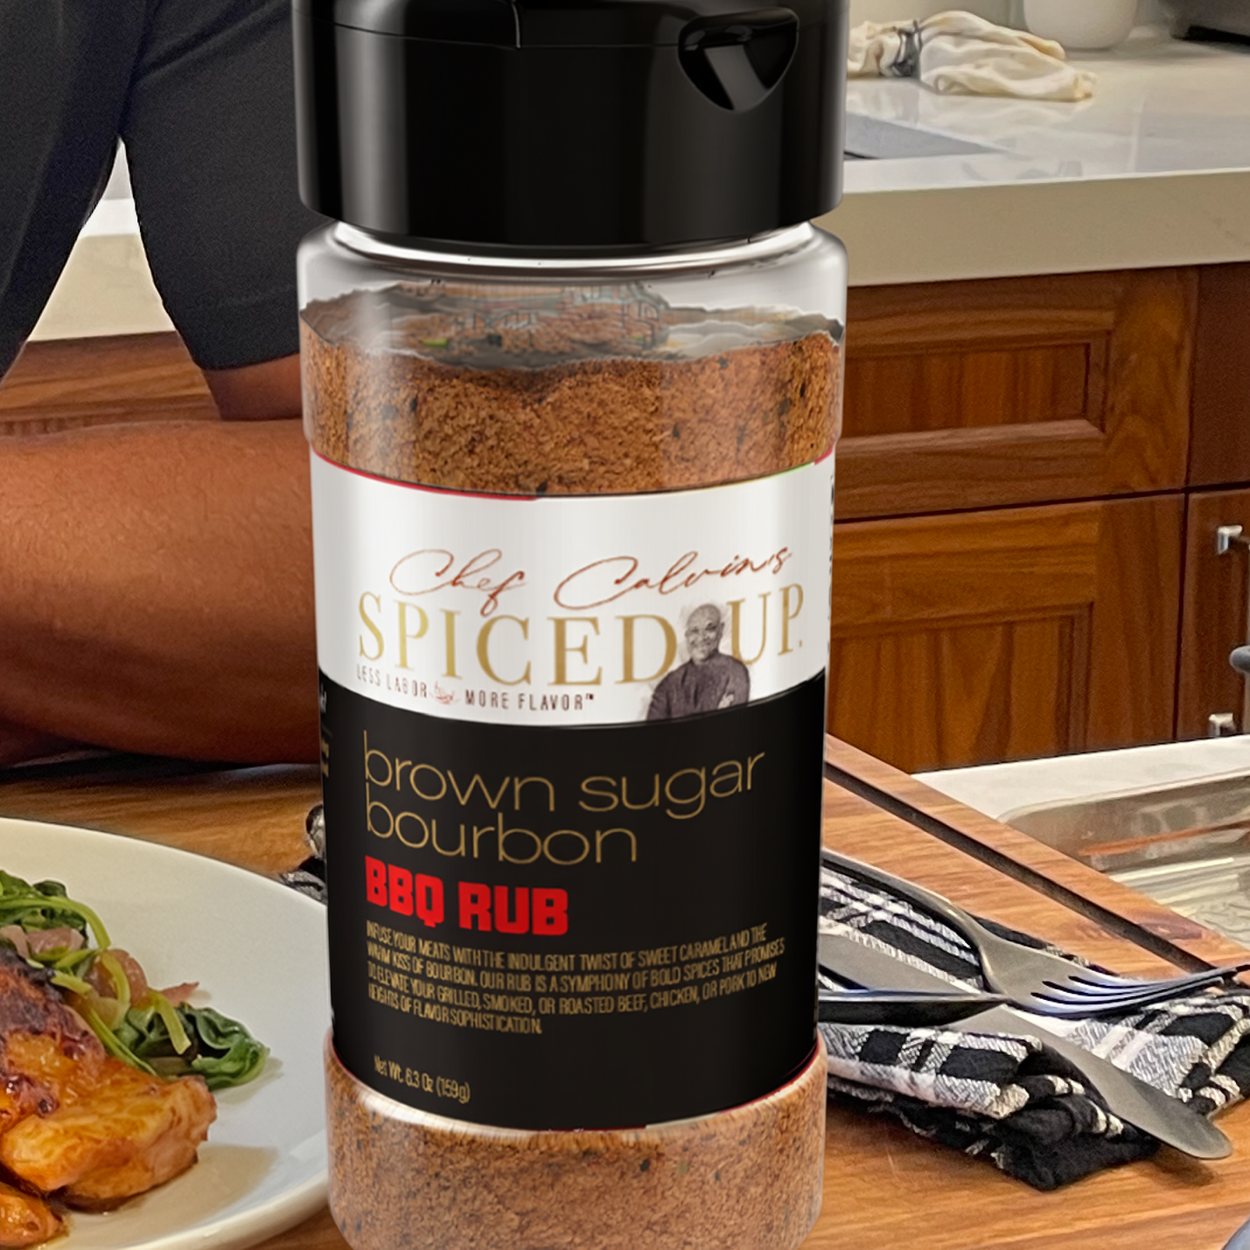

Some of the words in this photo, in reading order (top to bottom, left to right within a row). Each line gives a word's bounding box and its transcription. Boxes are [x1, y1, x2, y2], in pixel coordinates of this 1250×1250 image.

[389, 548, 528, 617] Chef
[356, 591, 678, 687] SPICED
[356, 663, 381, 686] LESS
[386, 674, 428, 699] LABOR
[464, 688, 509, 710] MORE
[363, 730, 555, 812] brown
[578, 752, 766, 819] sugar
[365, 781, 638, 865] bourbon
[364, 855, 445, 928] BBQ
[457, 881, 569, 936] RUB
[392, 930, 416, 953] YOUR
[418, 937, 451, 962] MEATS
[452, 945, 481, 967] WITH
[482, 949, 506, 969] THE
[507, 952, 575, 971] INDULGENT
[579, 952, 618, 971] TWIST
[619, 950, 636, 969] OF
[638, 945, 678, 967] SWEET
[679, 936, 729, 962] CARAMEL
[730, 929, 750, 951] AND
[750, 922, 768, 945] THE
[392, 950, 411, 972] KISS
[412, 956, 424, 975] OF
[425, 960, 479, 987] BOURBON.
[479, 970, 505, 990] OUR
[506, 973, 532, 992] RUB
[534, 974, 547, 993] IS
[549, 974, 559, 993] A
[559, 972, 630, 993] SYMPHONY
[632, 969, 649, 990] OF
[651, 966, 681, 987] BOLD
[683, 958, 720, 982] SPICES
[721, 951, 744, 973] THAT
[744, 936, 786, 966] PROMISES
[400, 995, 412, 1013] OF
[413, 998, 450, 1024] FLAVOR
[450, 1007, 543, 1035] SOPHISTICATION.
[410, 977, 435, 1000] YOUR
[436, 985, 482, 1011] GRILLED,
[482, 993, 536, 1017] SMOKED,
[538, 996, 556, 1015] OR
[558, 995, 615, 1015] ROASTED
[617, 993, 648, 1013] BEEF,
[650, 985, 701, 1010] CHICKEN,
[702, 980, 718, 1001] OR
[719, 972, 745, 996] PORK
[746, 969, 757, 989] TO
[758, 960, 778, 985] NEW
[374, 1054, 388, 1077] Net
[421, 1072, 434, 1093] Oz
[436, 1075, 471, 1105] (159g)
